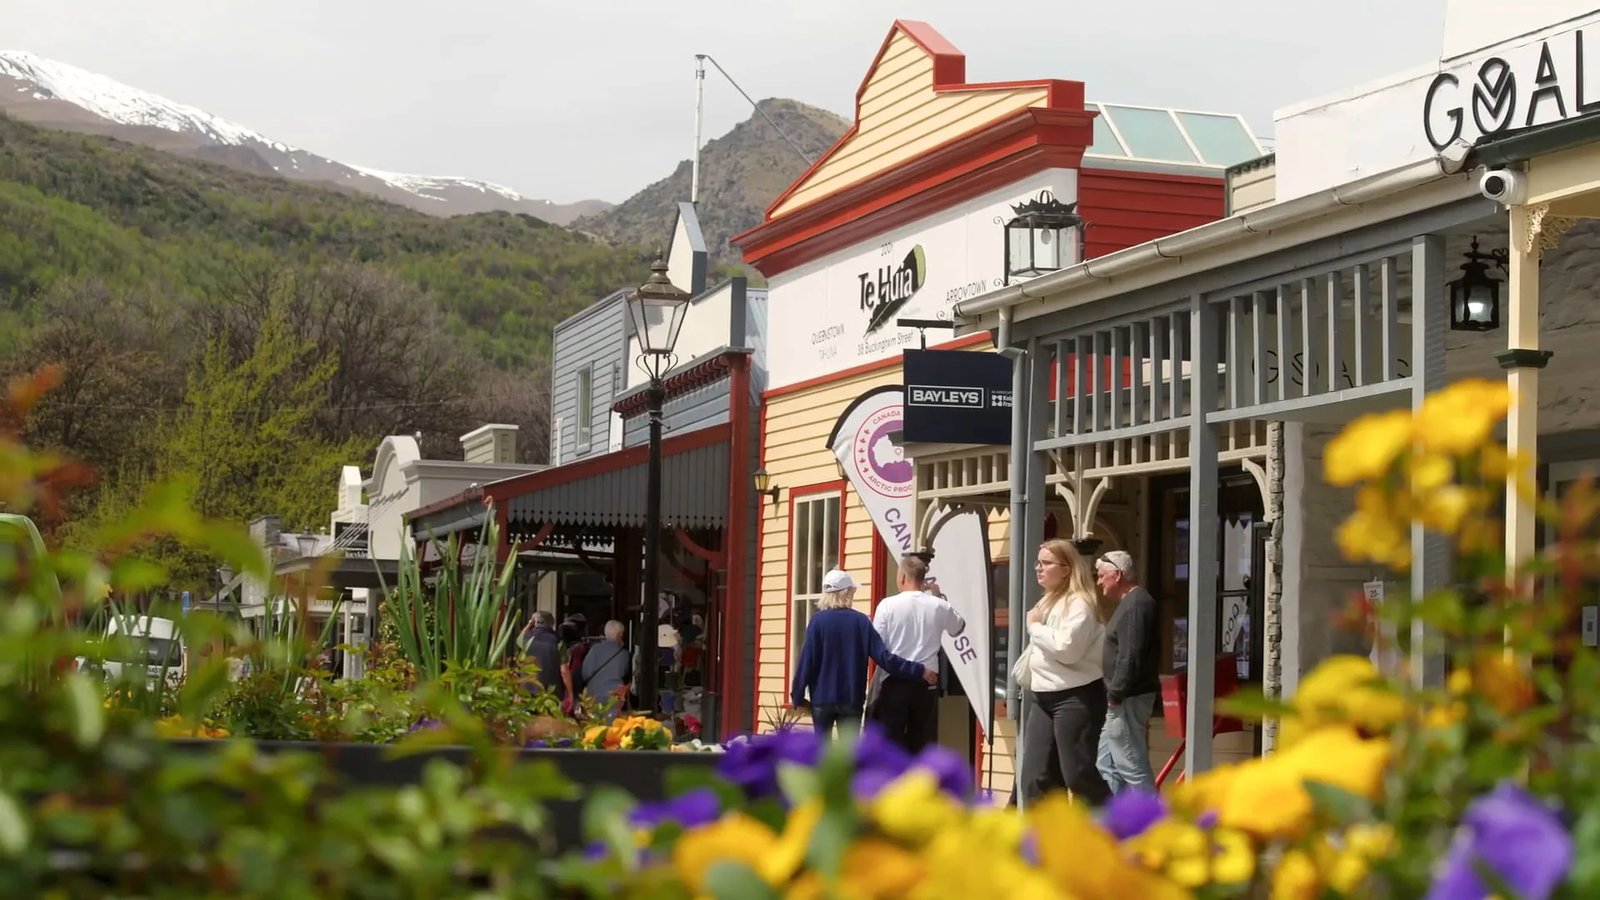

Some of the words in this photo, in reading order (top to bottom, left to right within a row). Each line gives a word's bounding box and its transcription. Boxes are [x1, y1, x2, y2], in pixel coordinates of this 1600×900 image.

[858, 272, 875, 311] Te
[878, 261, 912, 303] Huia
[897, 330, 914, 345] Street
[913, 389, 979, 404] BAYLEYS
[872, 410, 900, 425] CANADA
[868, 475, 893, 492] ARCTIC
